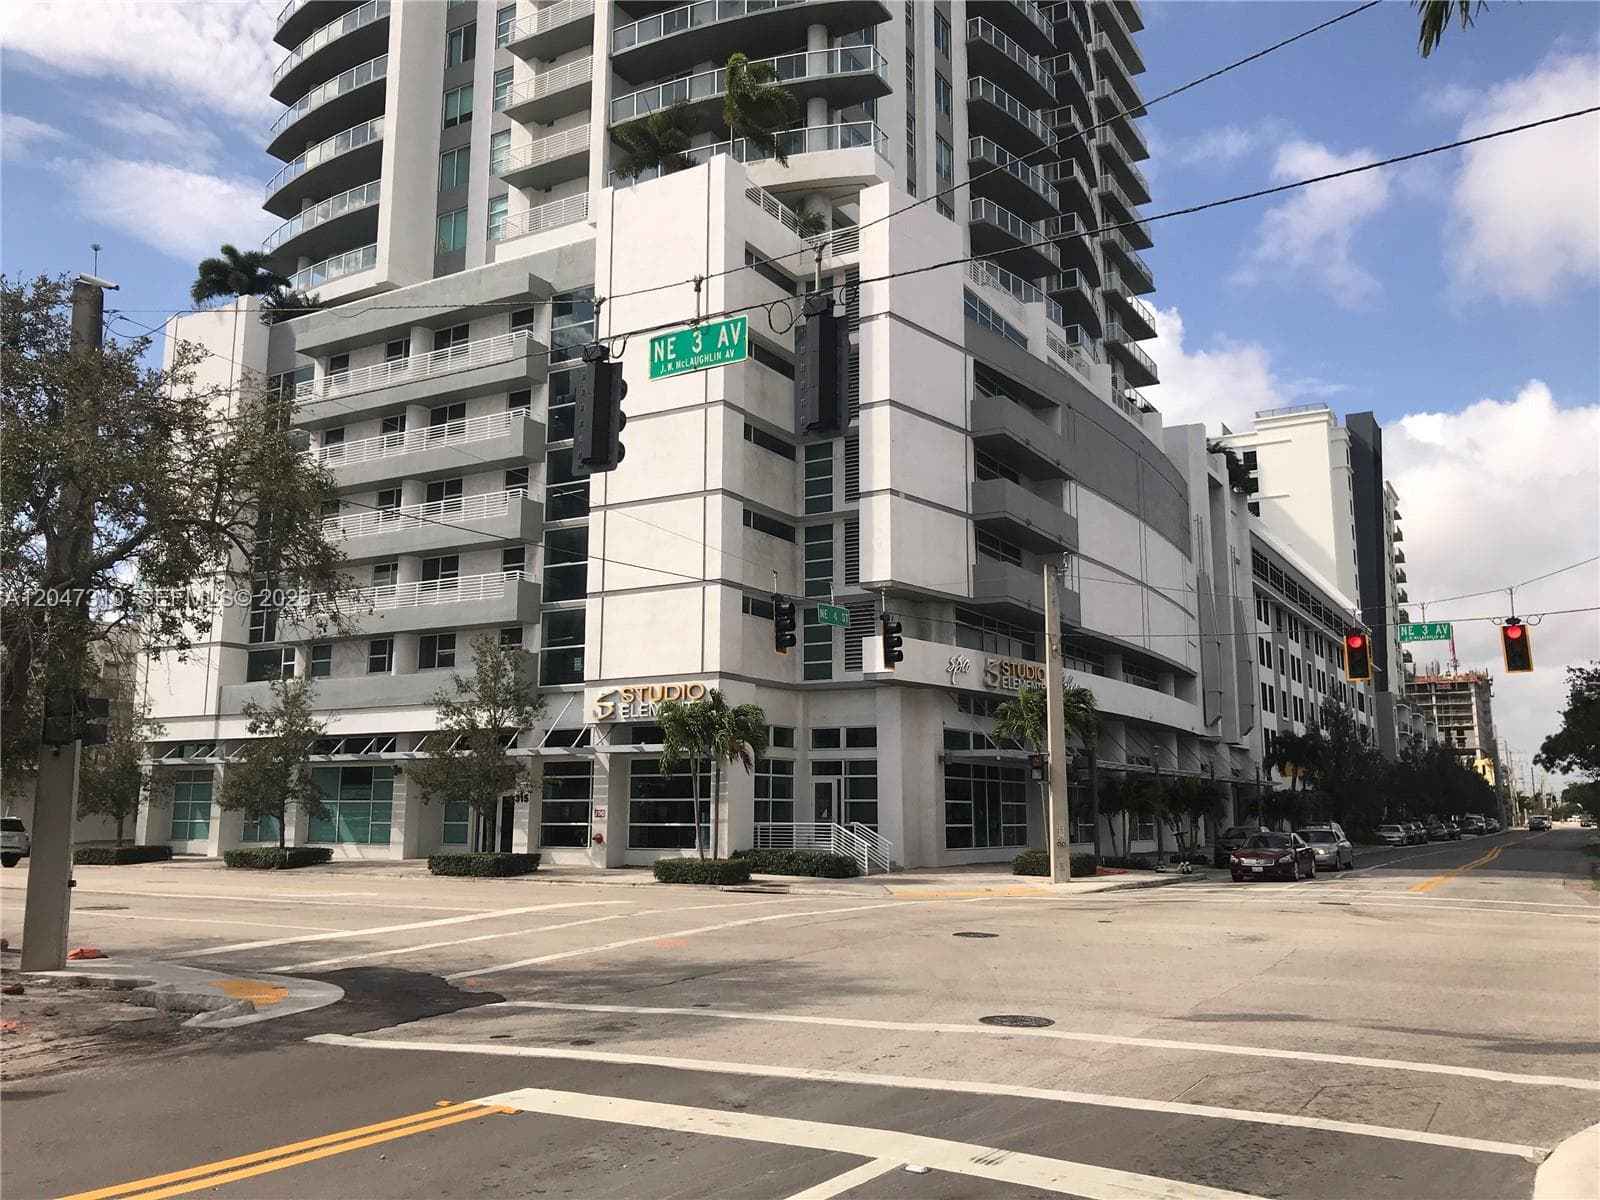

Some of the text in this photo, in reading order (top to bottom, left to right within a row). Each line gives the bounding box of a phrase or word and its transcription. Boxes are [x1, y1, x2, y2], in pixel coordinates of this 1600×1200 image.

[654, 321, 741, 363] NE 3 AV
[660, 348, 735, 375] J.W. McLAUGHLIN AV
[820, 608, 828, 620] NE
[1400, 624, 1448, 636] NE 3 AV
[1002, 660, 1045, 681] STUDIO
[621, 683, 706, 703] STUDIO
[514, 793, 529, 803] 315
